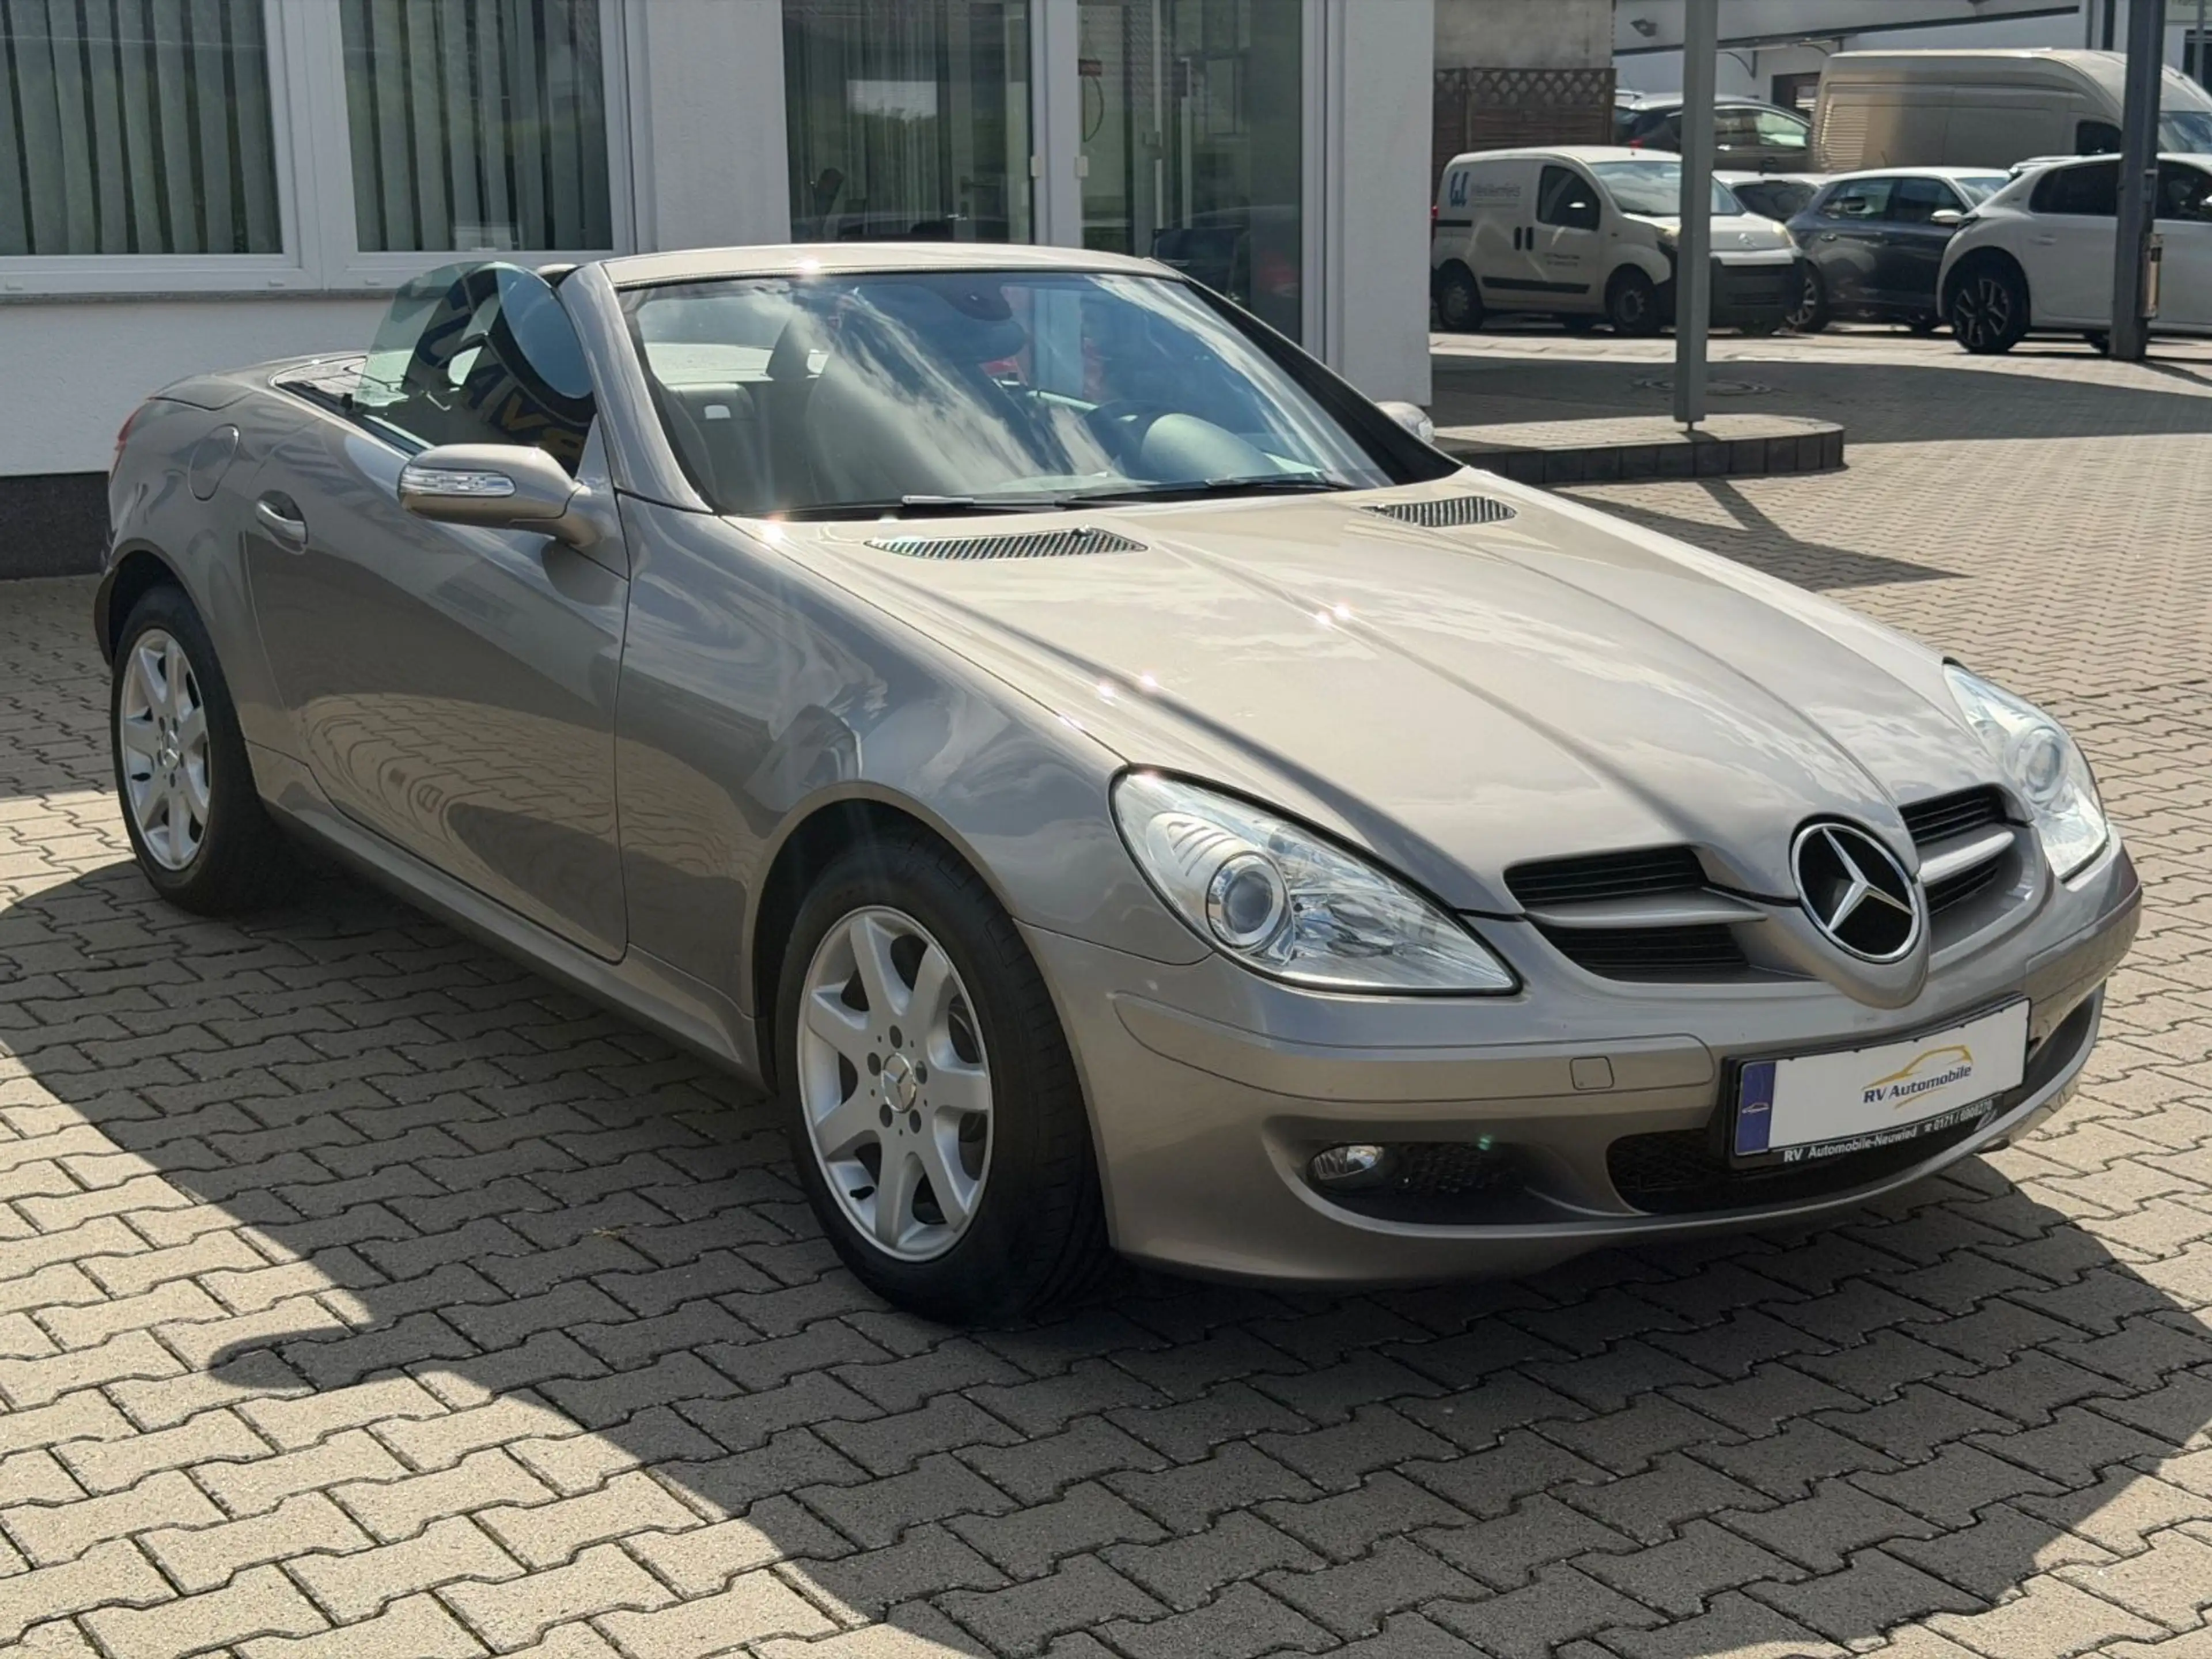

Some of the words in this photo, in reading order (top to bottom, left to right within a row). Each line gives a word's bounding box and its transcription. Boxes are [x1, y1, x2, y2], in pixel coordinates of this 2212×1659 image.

[1863, 1088, 1887, 1103] RV
[1889, 1066, 1971, 1099] Automobile
[1784, 1149, 1803, 1162] RV
